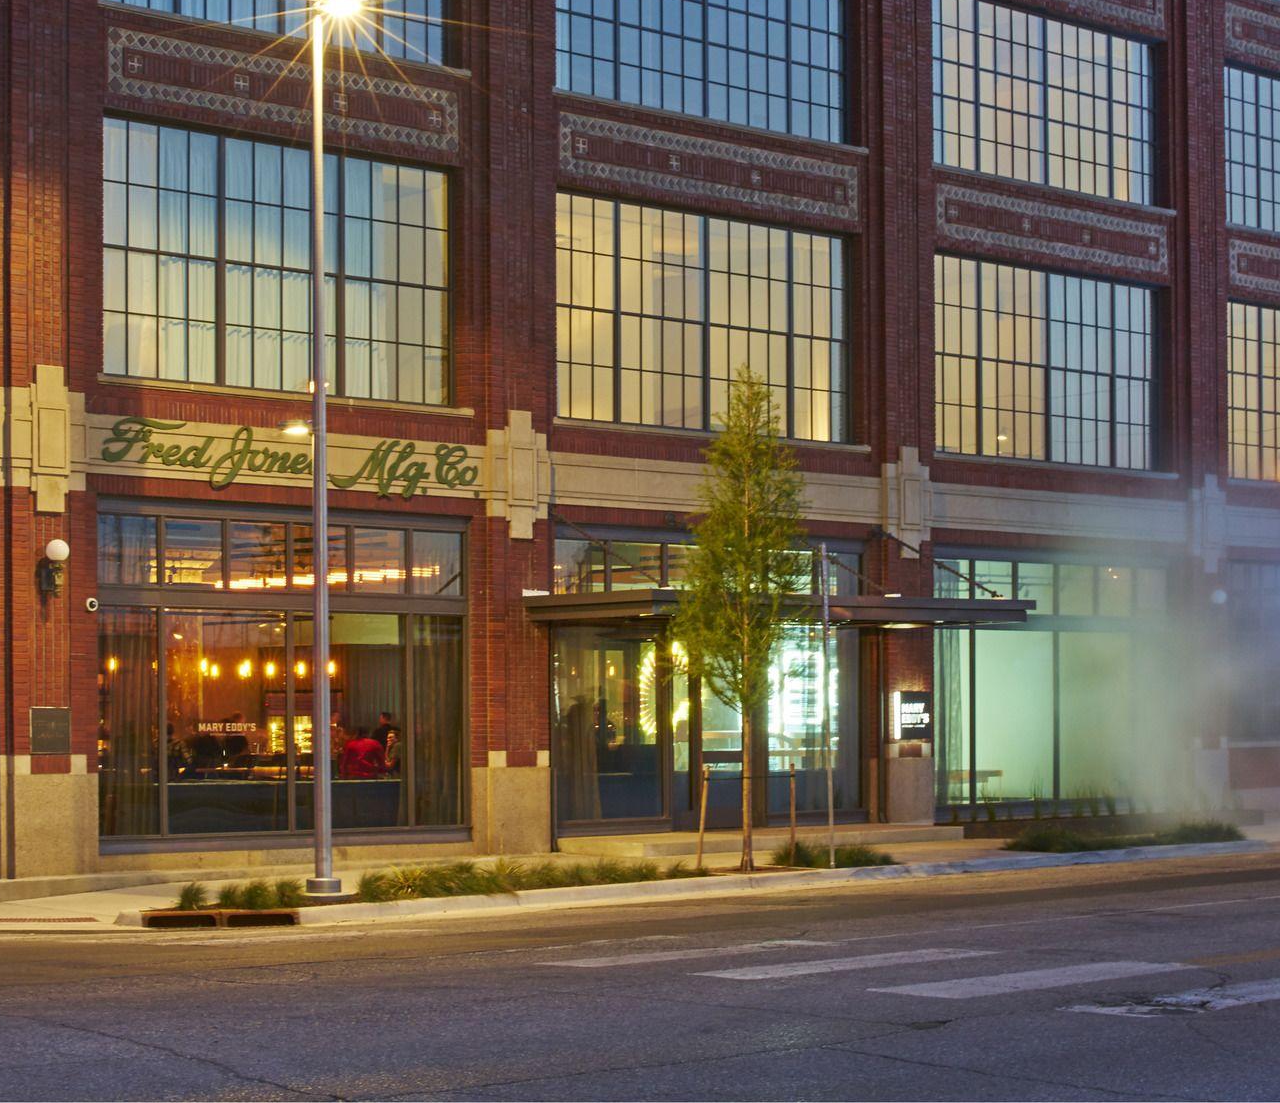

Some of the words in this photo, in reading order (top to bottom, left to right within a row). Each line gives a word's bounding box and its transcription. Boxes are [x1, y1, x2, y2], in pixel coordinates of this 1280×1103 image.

[102, 416, 214, 468] Fred
[209, 426, 312, 490] Jone
[328, 440, 431, 500] Mfg.
[435, 444, 480, 498] Co.
[198, 722, 224, 732] MARY
[225, 722, 257, 732] EDDY'S
